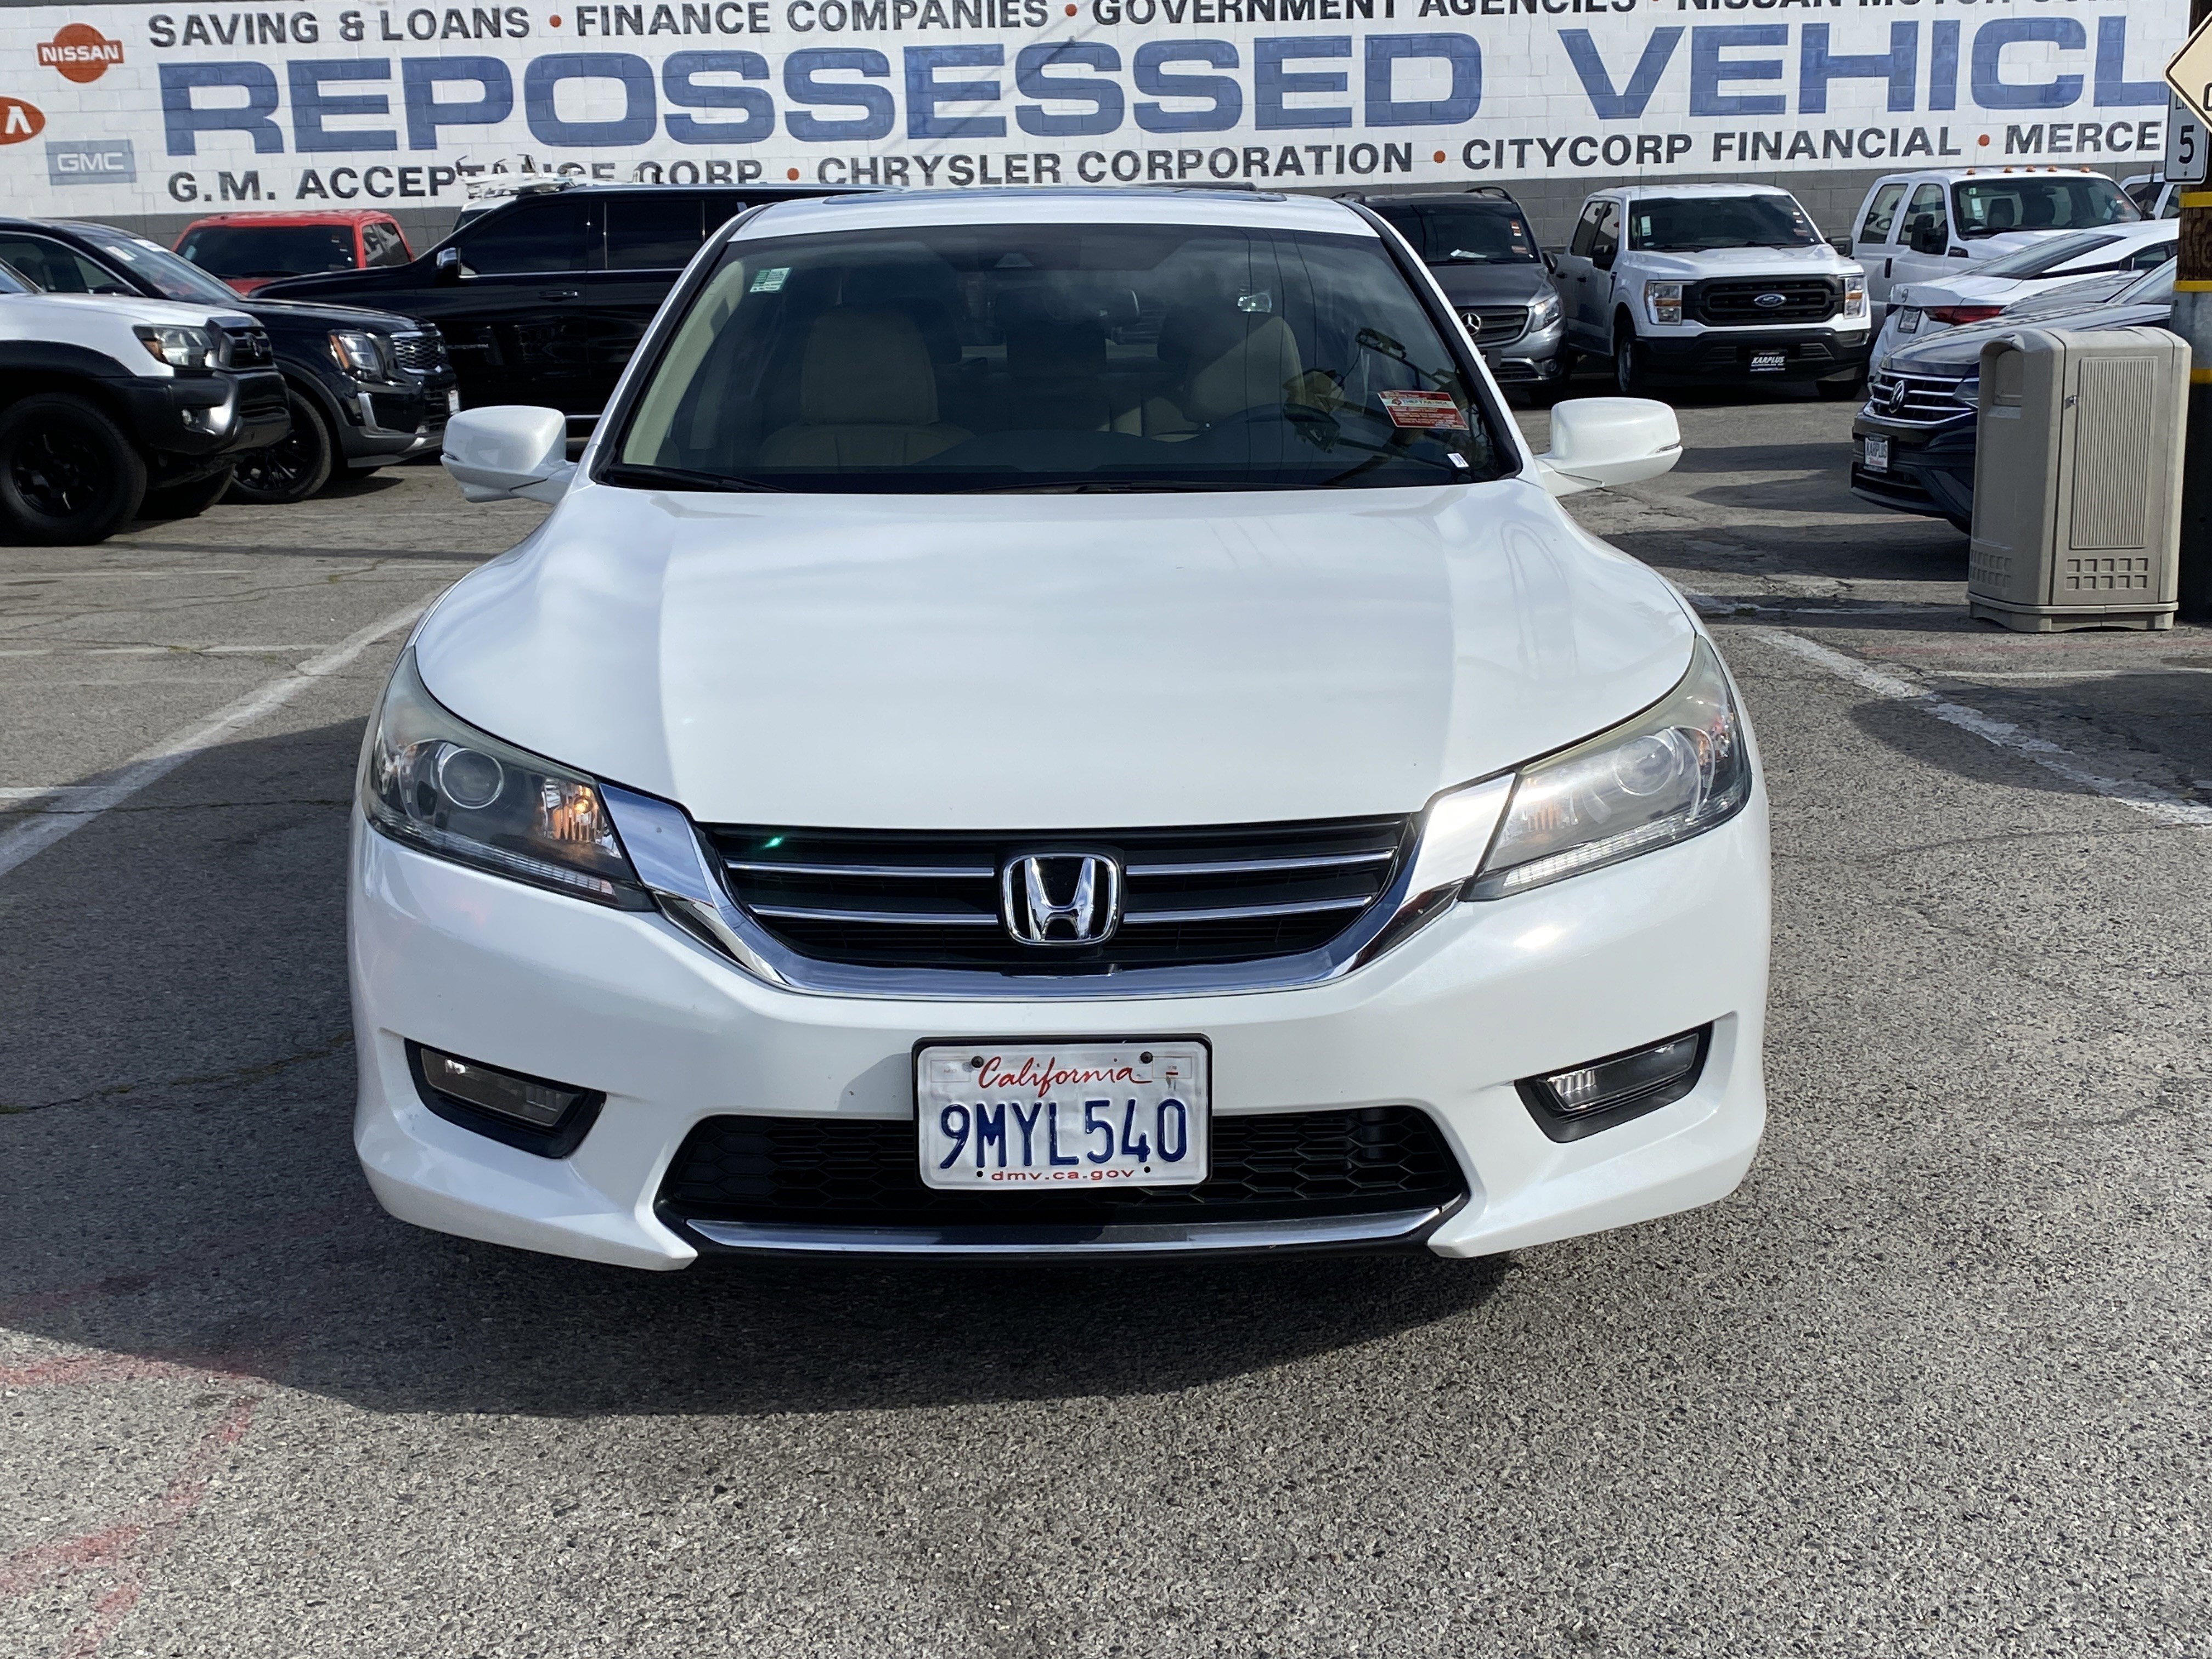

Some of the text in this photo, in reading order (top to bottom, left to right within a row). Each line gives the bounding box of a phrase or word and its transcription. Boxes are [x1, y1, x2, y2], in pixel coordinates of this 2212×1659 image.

[149, 12, 318, 48] SAVING
[340, 11, 364, 42] &
[380, 7, 529, 41] LOANS
[576, 2, 771, 36] FINANCE
[787, 0, 1048, 32] COMPANIES
[41, 45, 119, 63] NISSAN
[158, 32, 1483, 156] REPOSSESSED
[57, 151, 125, 172] GMC
[168, 170, 275, 202] G.M.
[818, 153, 1061, 186] CHRYSLER
[1077, 142, 1413, 183] CORPORATION
[1463, 134, 1692, 170] CITYCORP
[1713, 126, 1962, 162] FINANCIAL
[2005, 121, 2162, 154] MERCE
[2178, 125, 2194, 164] 5
[978, 1056, 1153, 1098] California
[940, 1098, 1187, 1169] 9MYL540
[991, 1168, 1135, 1181] dmv.ca.gov
